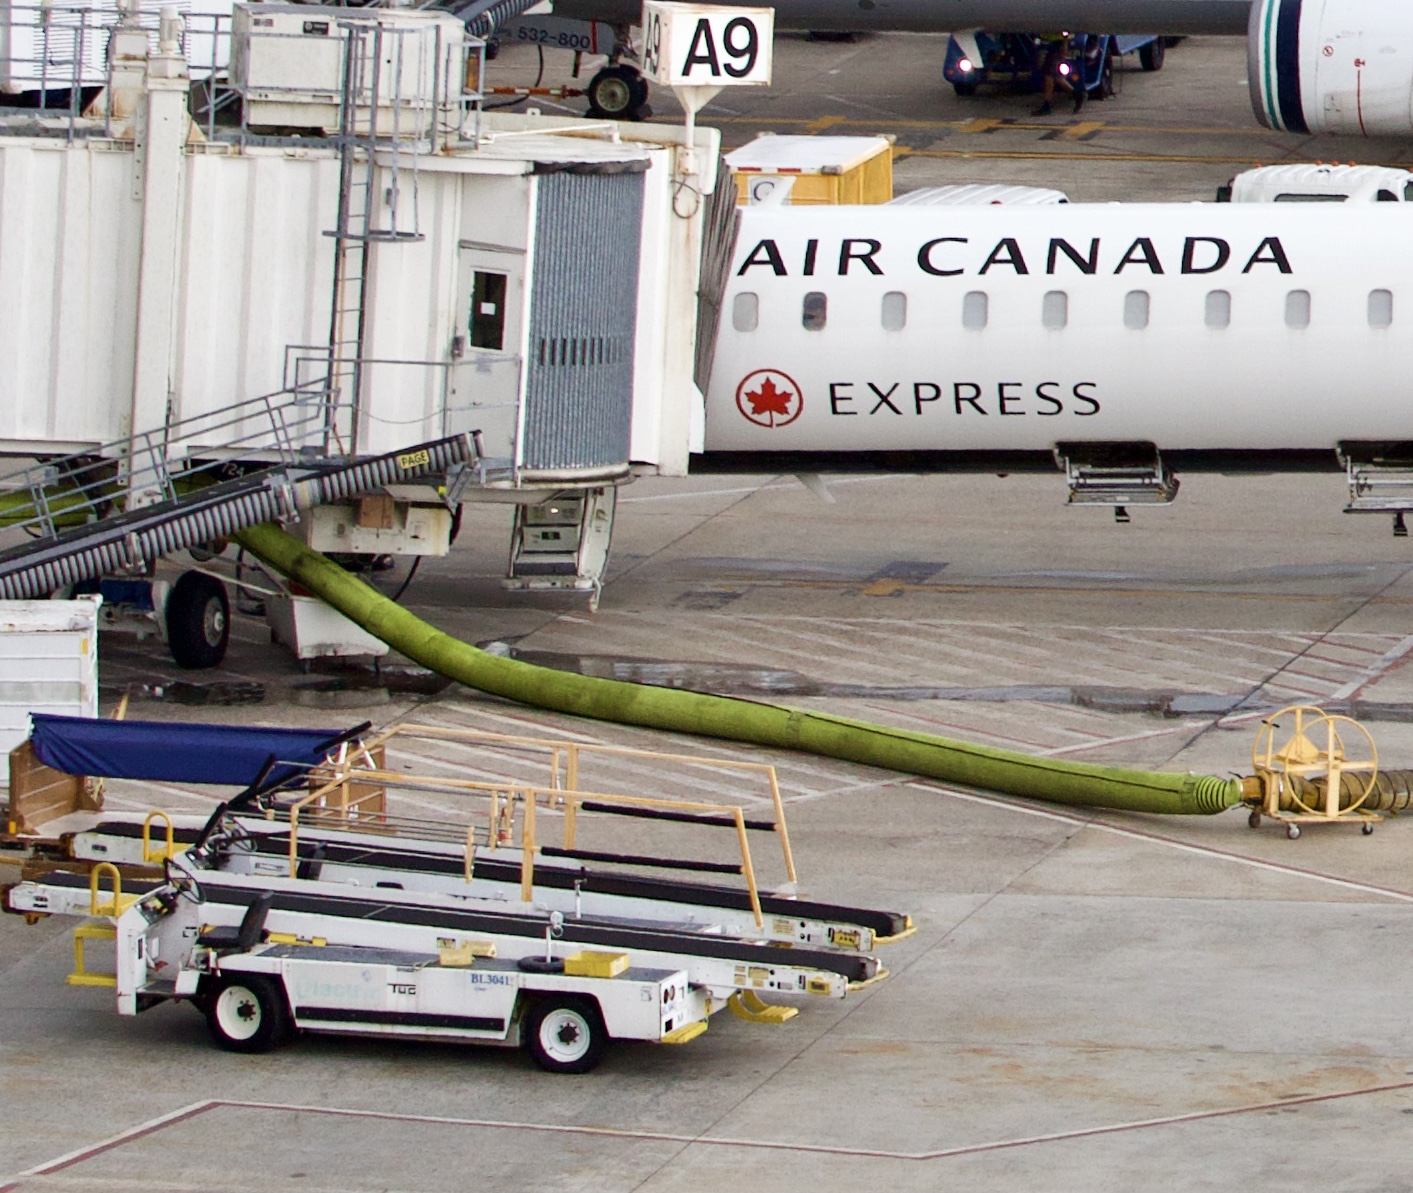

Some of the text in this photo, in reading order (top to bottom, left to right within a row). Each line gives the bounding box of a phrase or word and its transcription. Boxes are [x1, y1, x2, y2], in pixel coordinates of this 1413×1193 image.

[518, 26, 591, 49] 532-800
[643, 11, 660, 76] A9
[681, 16, 759, 79] A9
[737, 236, 1293, 277] AIR CANADA
[828, 381, 1101, 417] EXPRESS
[470, 973, 510, 986] BL3041
